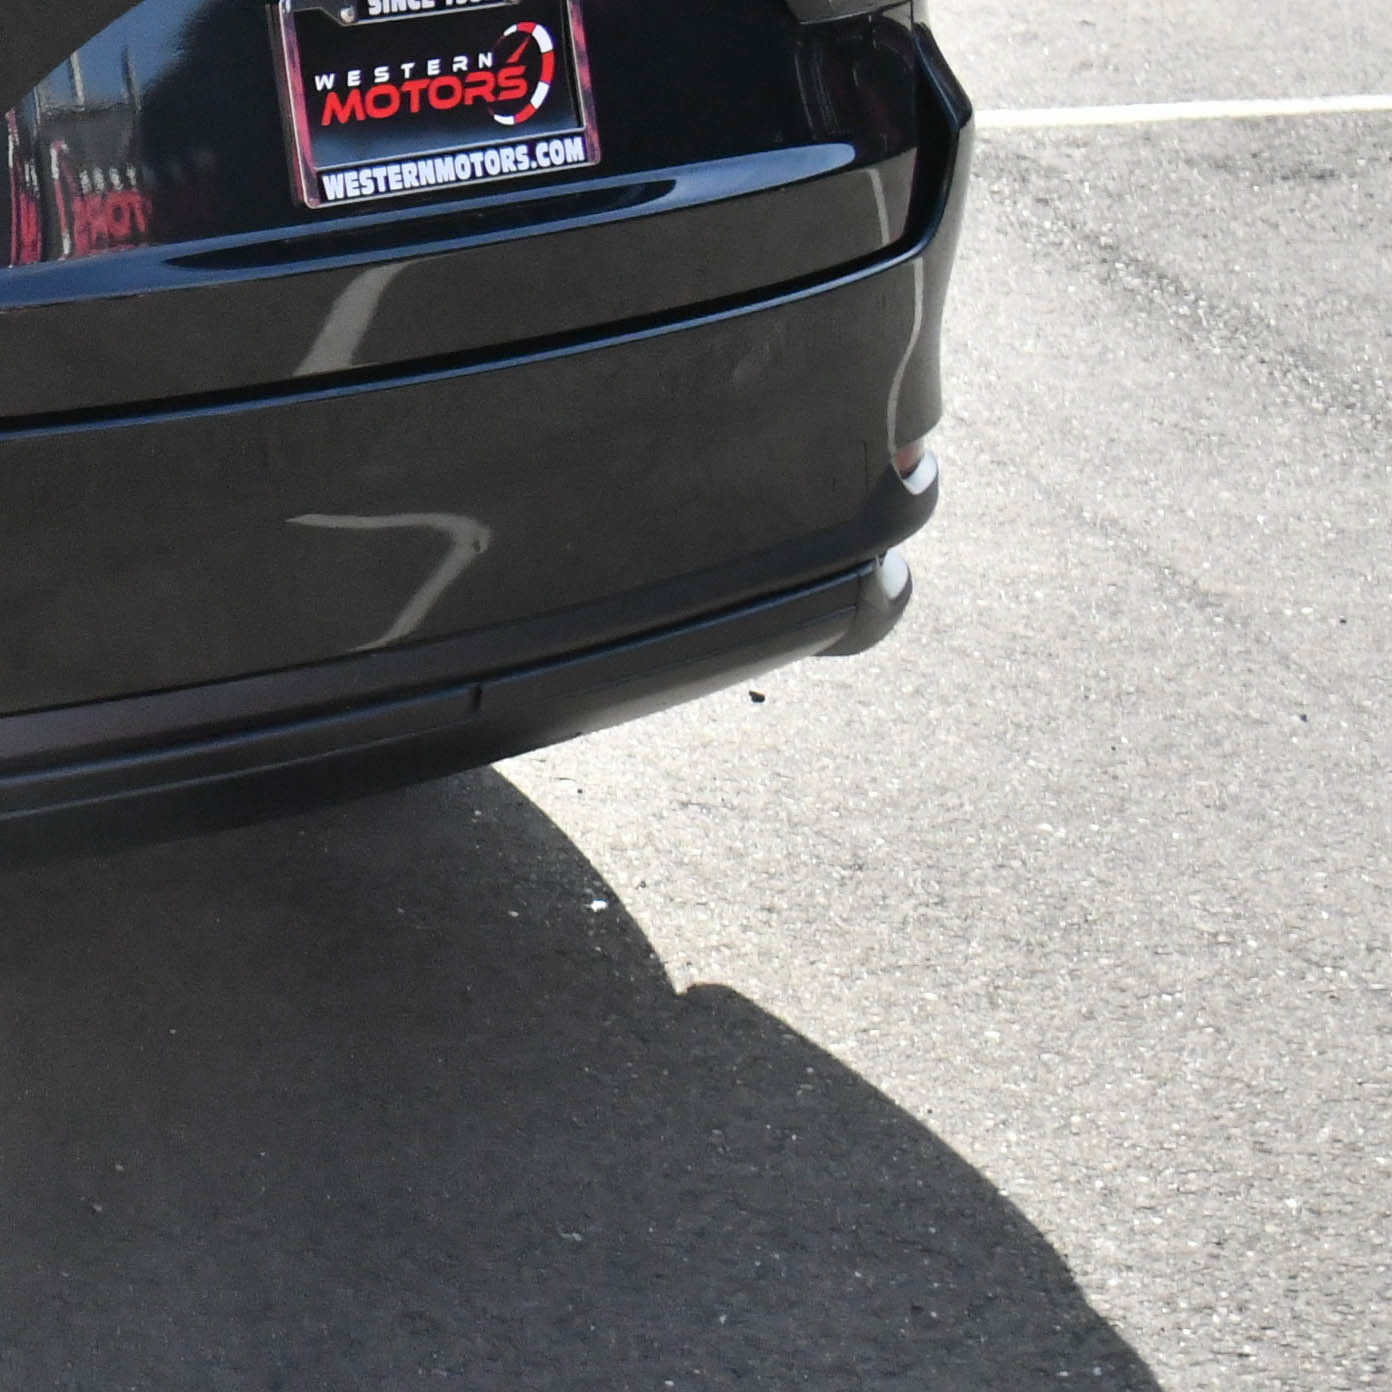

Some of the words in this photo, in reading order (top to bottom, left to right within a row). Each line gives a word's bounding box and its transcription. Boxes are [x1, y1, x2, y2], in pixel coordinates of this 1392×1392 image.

[315, 52, 494, 91] WESTERN
[321, 65, 529, 127] MOTORS
[322, 136, 586, 201] WESTERNMOTORS.COM
